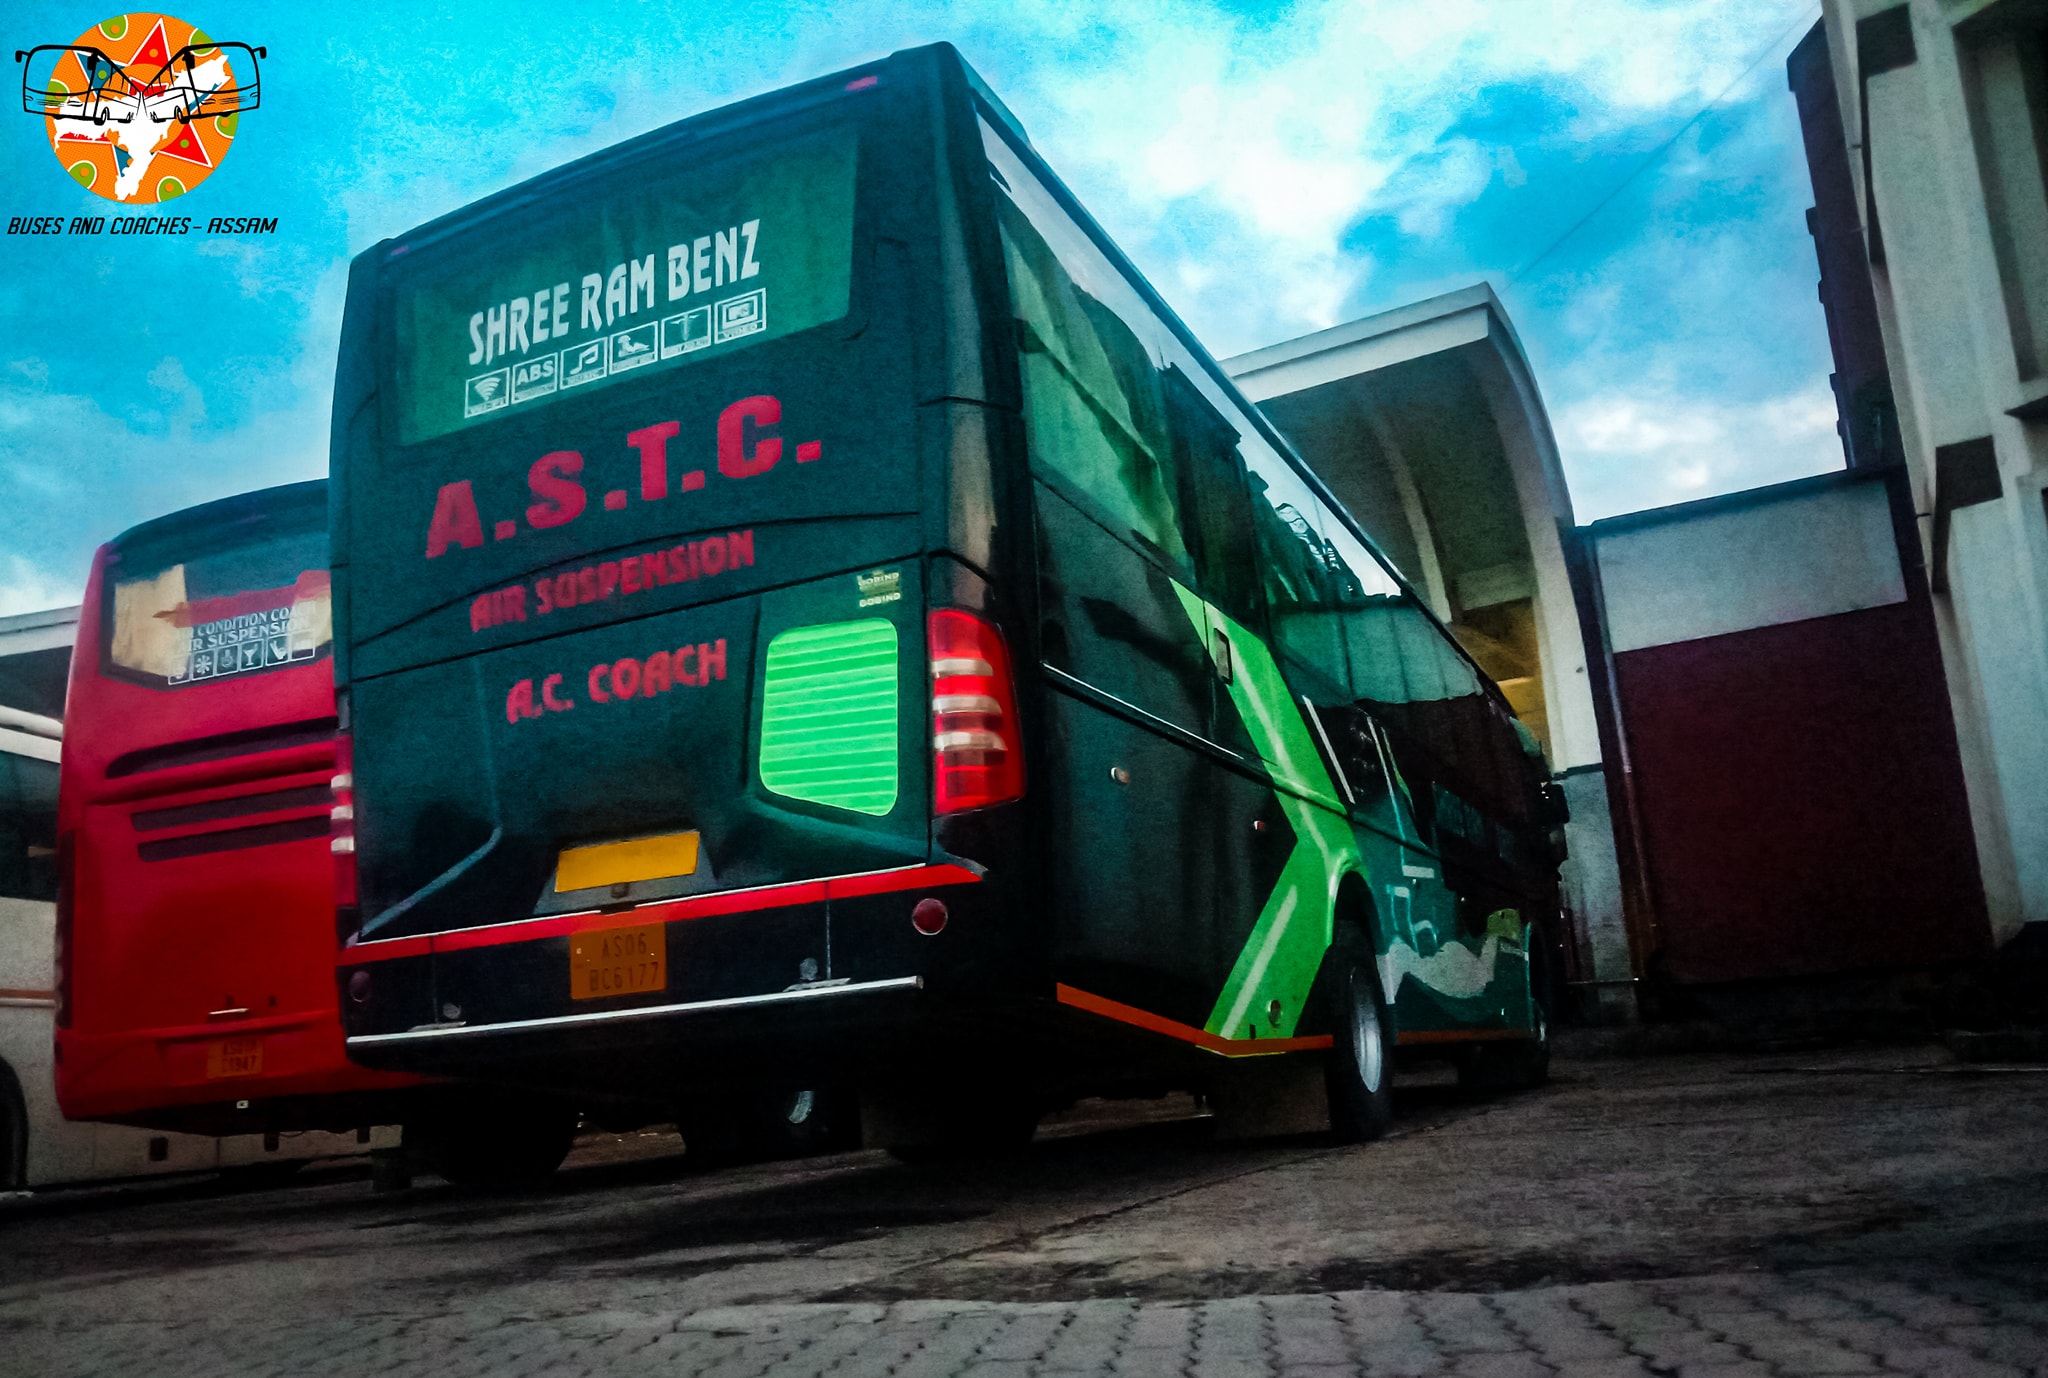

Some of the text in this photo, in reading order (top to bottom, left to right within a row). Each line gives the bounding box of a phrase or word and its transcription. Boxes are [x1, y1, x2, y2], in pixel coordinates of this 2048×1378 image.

[469, 218, 760, 365] SHREE RAM BENZ
[516, 360, 555, 386] ABS
[426, 395, 822, 559] A.S.T.C.
[470, 530, 755, 632] AIR SUSPENSION
[197, 612, 267, 636] CONDITION
[506, 639, 727, 724] A.C. COACH
[602, 932, 647, 959] AS06
[590, 961, 659, 992] BC6177
